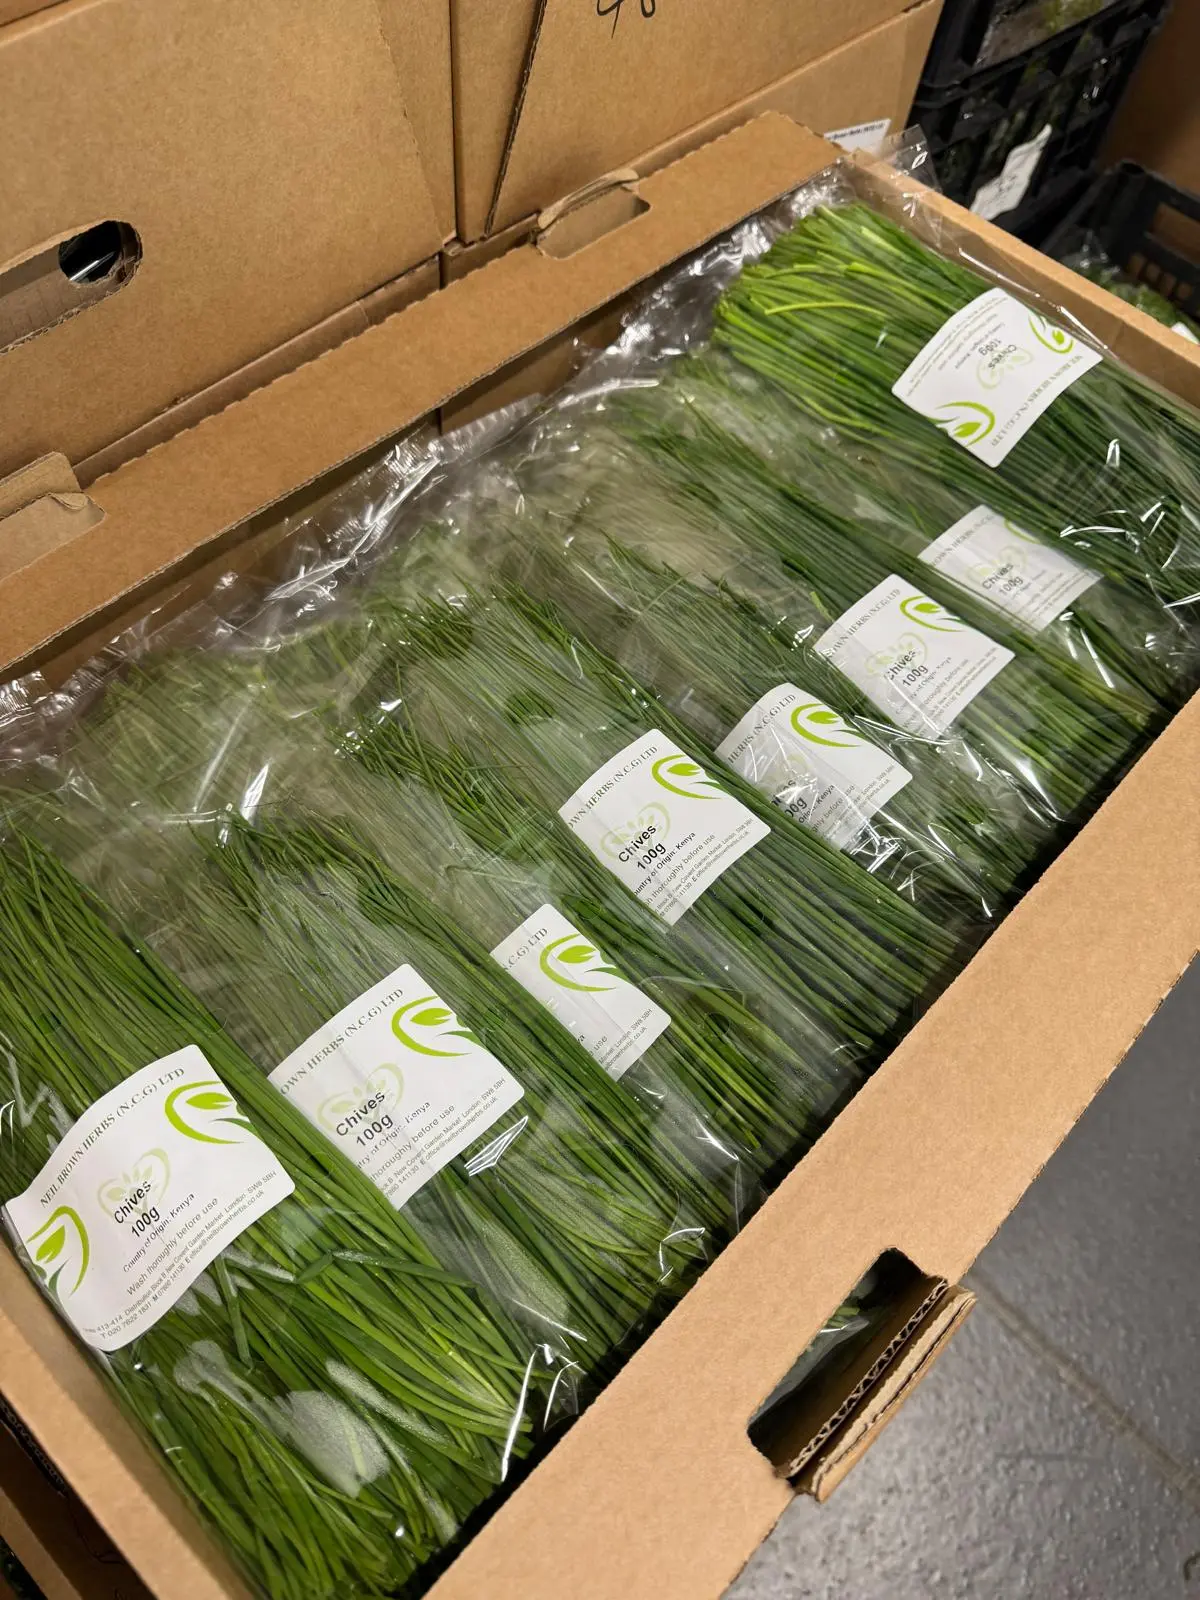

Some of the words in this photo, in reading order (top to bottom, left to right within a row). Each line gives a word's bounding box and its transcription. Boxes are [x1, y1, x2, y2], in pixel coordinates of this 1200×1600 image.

[902, 665, 929, 687] 100g
[585, 780, 615, 810] HERBS
[640, 746, 658, 761] LTD
[618, 825, 657, 863] Chives
[637, 842, 667, 870] 100g
[676, 832, 696, 851] Kenya
[652, 863, 684, 898] thoroughly
[682, 844, 704, 864] before
[703, 834, 715, 846] use
[528, 928, 548, 946] LTD
[306, 1034, 345, 1070] HERBS
[345, 1006, 382, 1037] (N.C.G)
[380, 989, 403, 1008] LTD
[336, 1092, 385, 1136] Chives
[356, 1114, 394, 1147] 100g
[411, 1118, 439, 1143] before
[439, 1104, 455, 1120] use
[40, 1183, 60, 1209] NEIL
[57, 1148, 84, 1185] BROWN
[82, 1113, 116, 1150] HERBS
[116, 1083, 158, 1118] (N.C.G)
[157, 1068, 185, 1087] LTD
[114, 1181, 152, 1224] Chives
[131, 1206, 160, 1238] 100g
[123, 1247, 147, 1273] Country
[170, 1193, 195, 1218] Kenya
[127, 1272, 148, 1296] Wash
[147, 1238, 178, 1275] thoroughly
[176, 1213, 201, 1239] before
[201, 1197, 218, 1215] use
